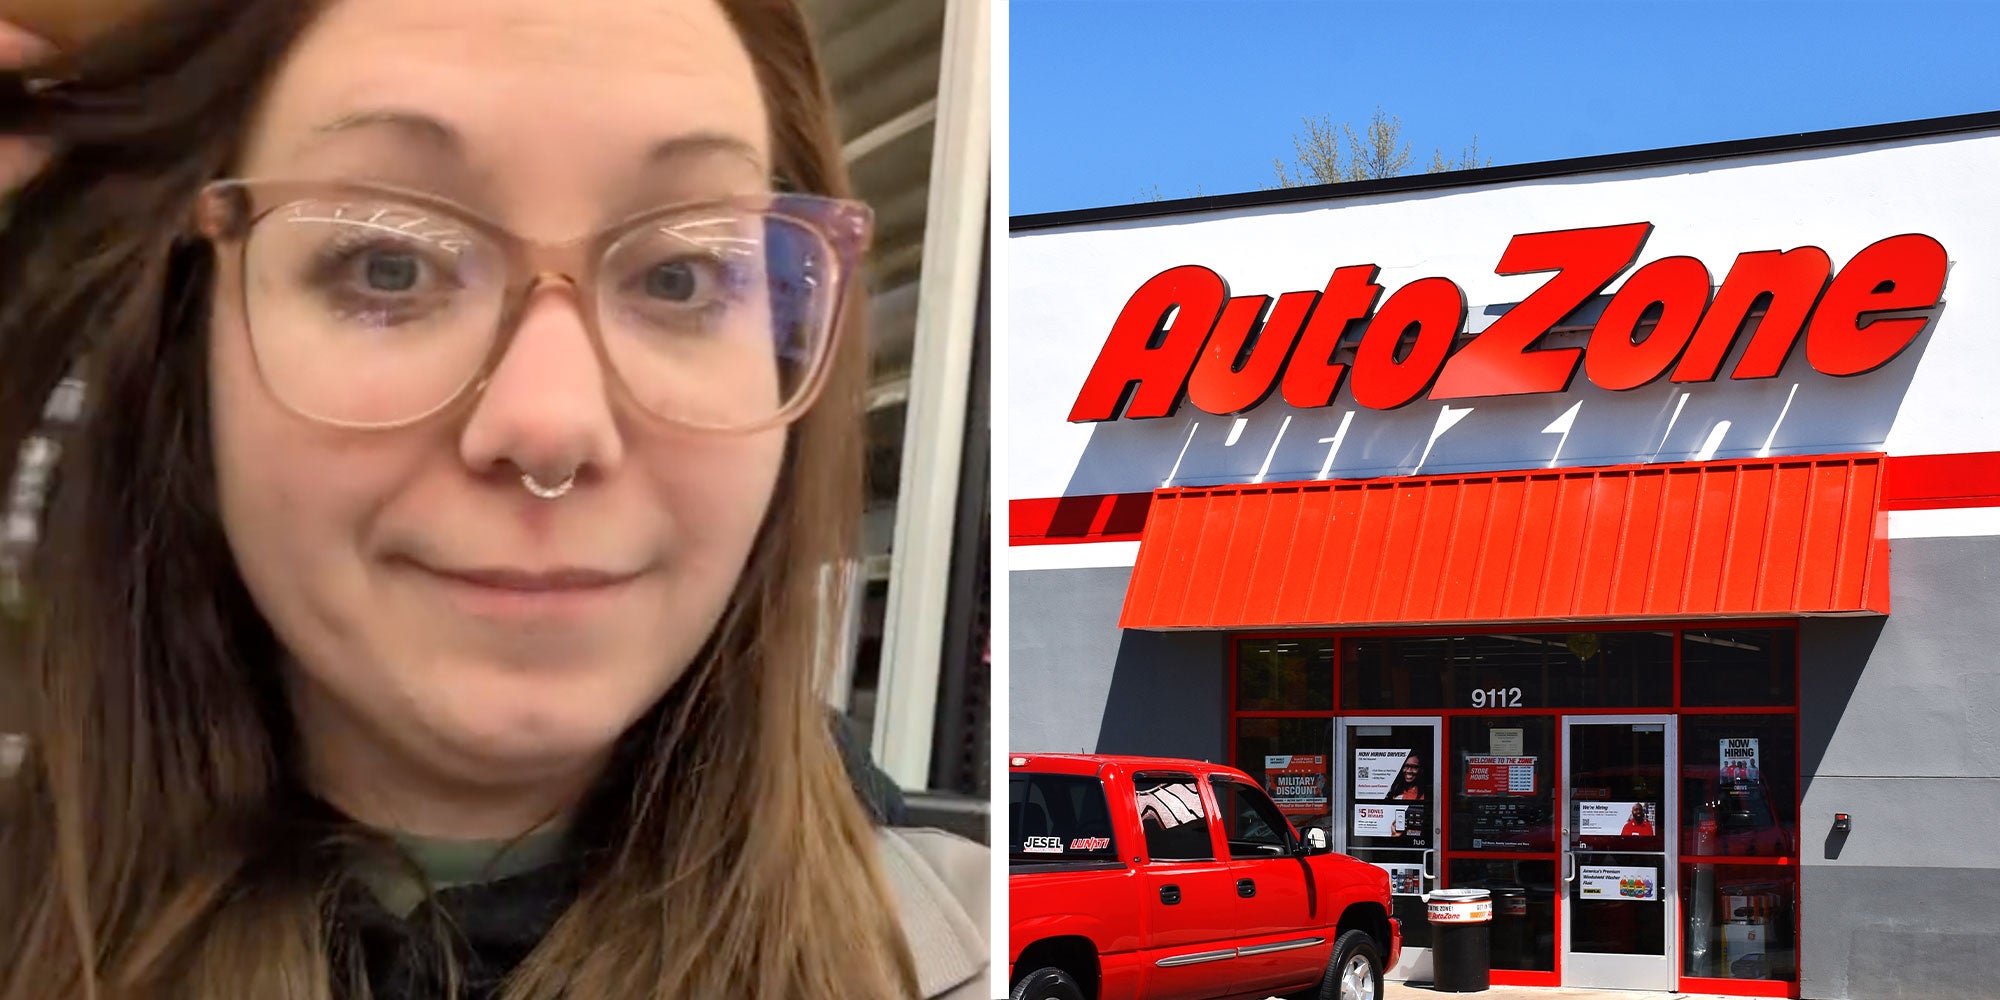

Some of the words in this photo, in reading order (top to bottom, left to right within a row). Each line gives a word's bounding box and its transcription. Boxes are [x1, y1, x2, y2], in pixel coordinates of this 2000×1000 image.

[1067, 221, 1951, 423] AutoZone
[1471, 687, 1523, 708] 9112
[1728, 739, 1750, 748] NOW
[1724, 748, 1754, 757] HIRING
[1470, 767, 1489, 775] STORE
[1277, 776, 1315, 786] MILITARY
[1276, 786, 1317, 795] DISCOUNT
[1024, 837, 1062, 849] JESEL
[1070, 837, 1110, 851] LUNATI
